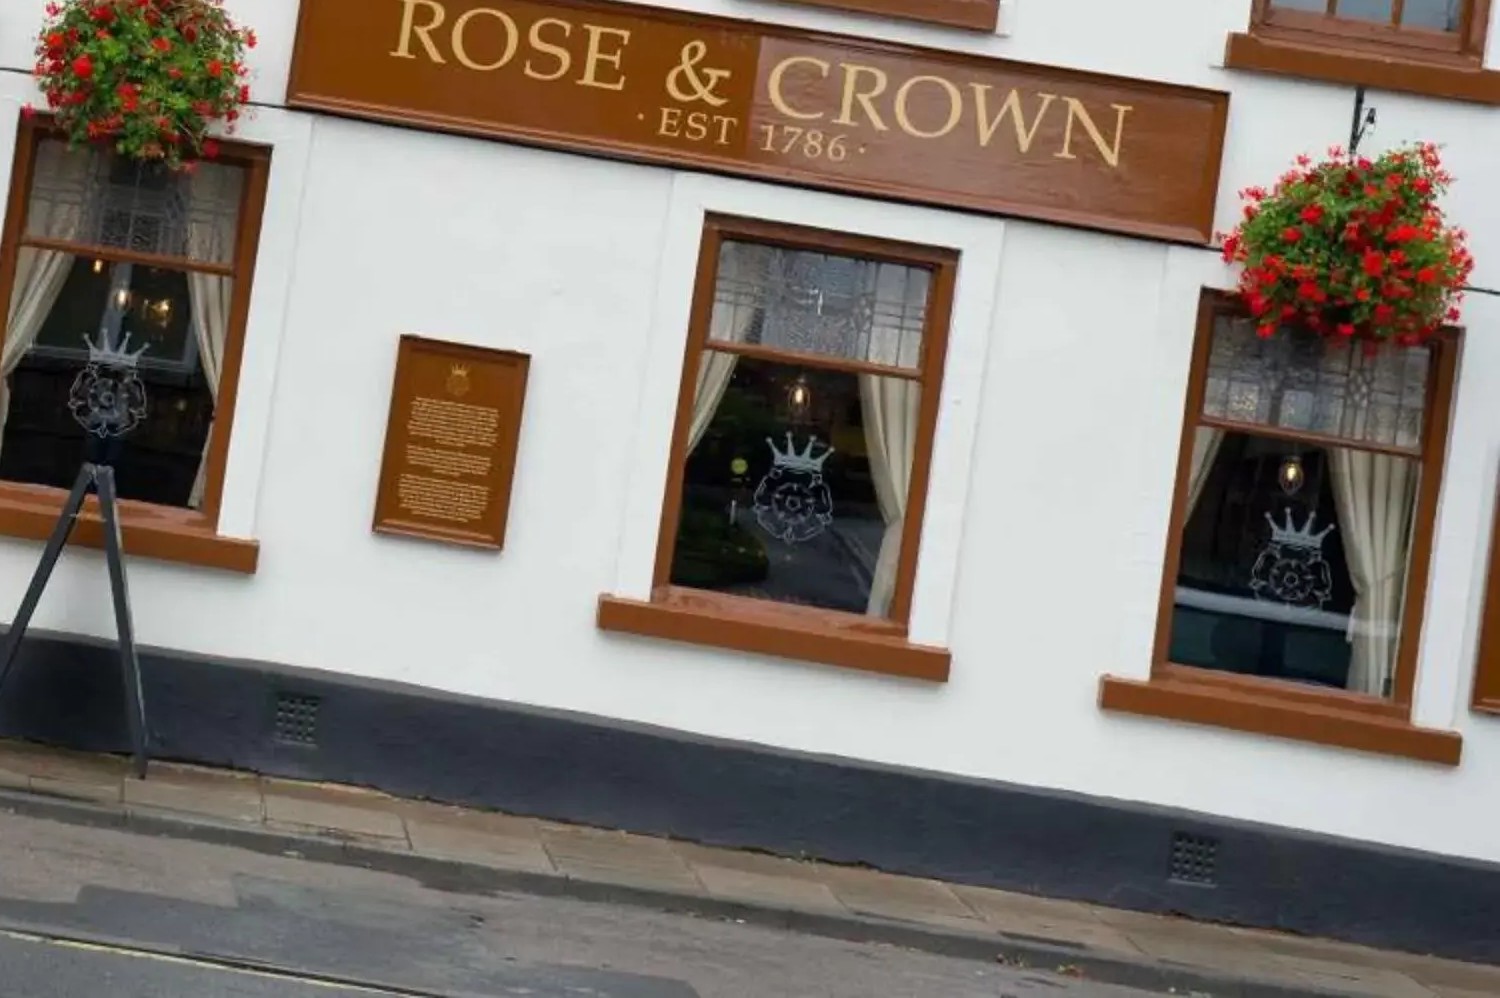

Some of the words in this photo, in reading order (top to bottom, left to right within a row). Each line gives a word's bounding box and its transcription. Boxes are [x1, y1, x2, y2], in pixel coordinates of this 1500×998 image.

[658, 107, 738, 145] EST
[760, 124, 849, 163] 1786
[665, 40, 731, 107] &
[767, 55, 1133, 168] CROWN
